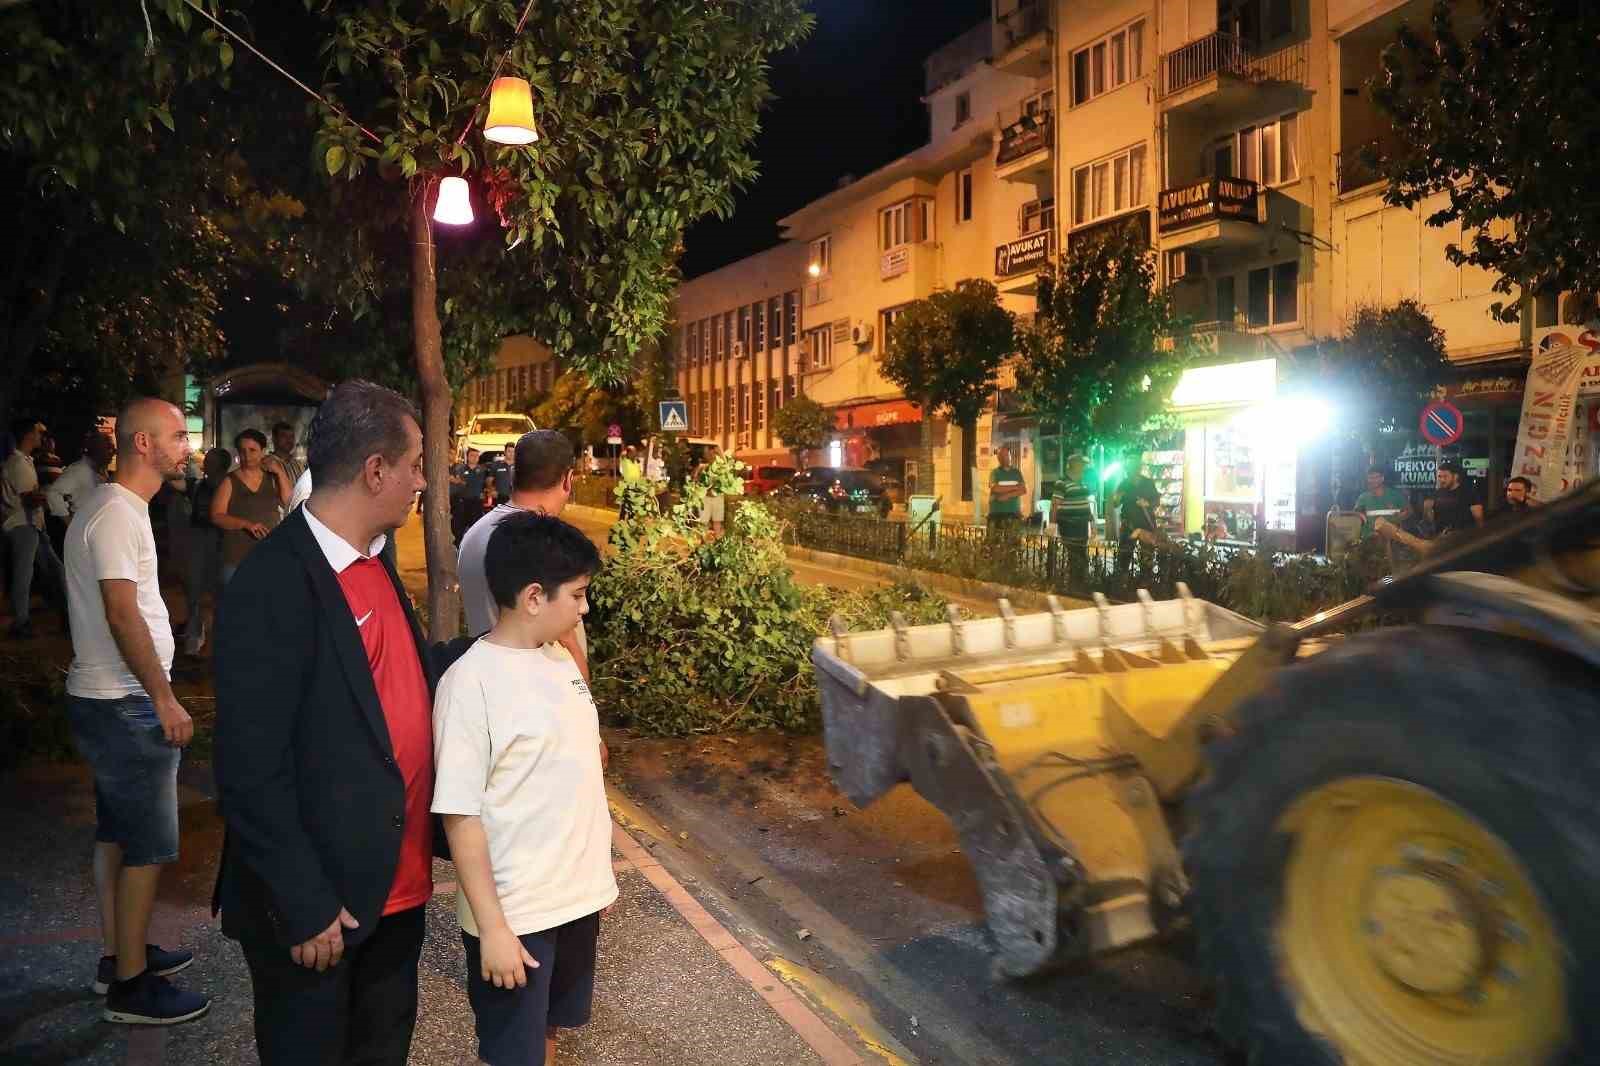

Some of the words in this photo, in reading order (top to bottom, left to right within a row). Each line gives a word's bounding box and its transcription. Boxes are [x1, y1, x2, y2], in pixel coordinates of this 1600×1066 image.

[1161, 182, 1210, 211] AVUKAT
[1010, 236, 1045, 256] AVUKAT
[1401, 471, 1439, 483] KUMA
